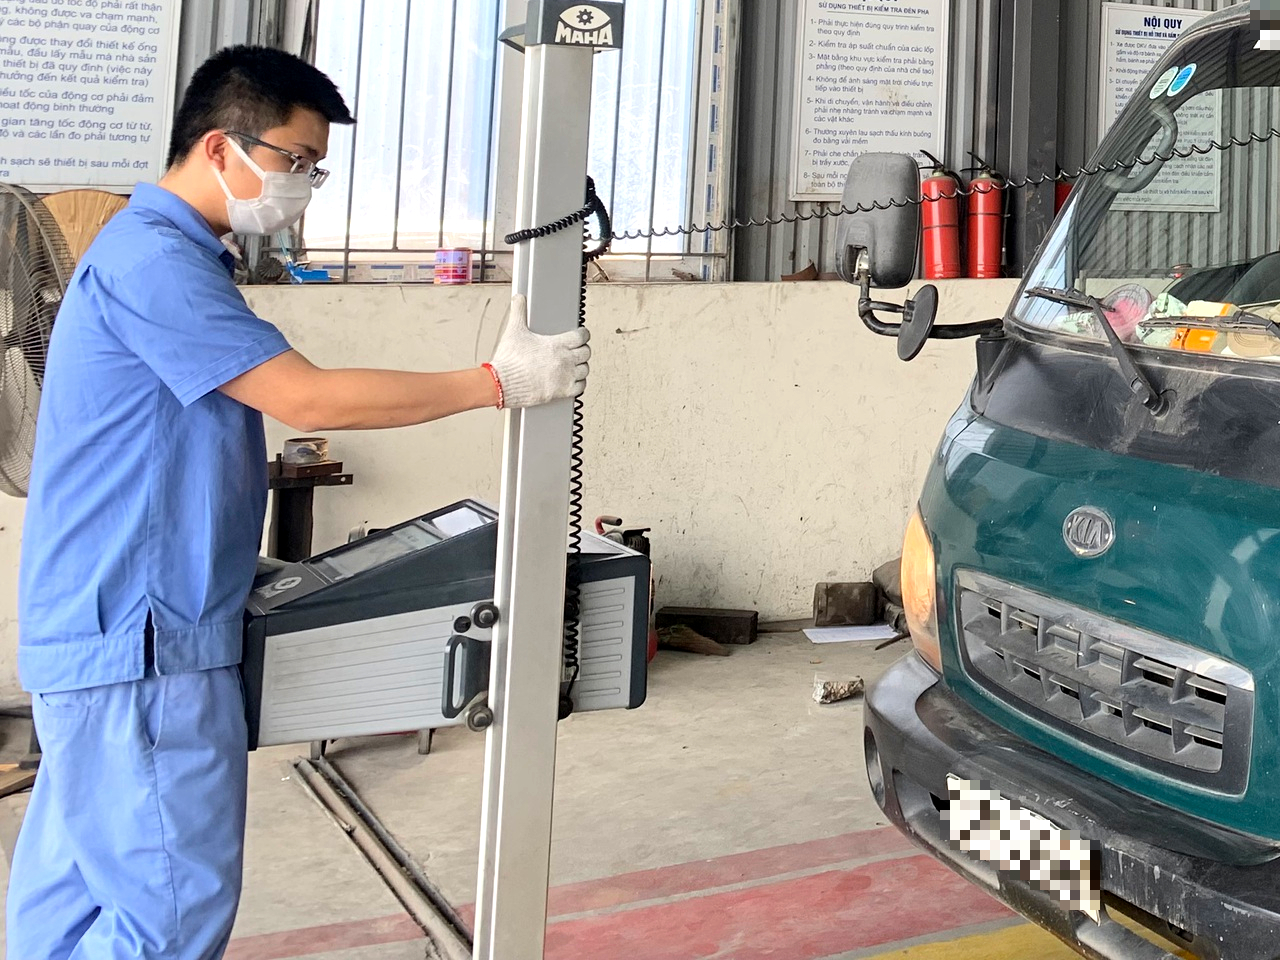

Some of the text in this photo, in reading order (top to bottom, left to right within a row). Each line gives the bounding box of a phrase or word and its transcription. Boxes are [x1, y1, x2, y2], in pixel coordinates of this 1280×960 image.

[555, 20, 613, 45] MAHA
[1144, 16, 1182, 29] NỘI QUY
[1069, 515, 1104, 547] KIA
